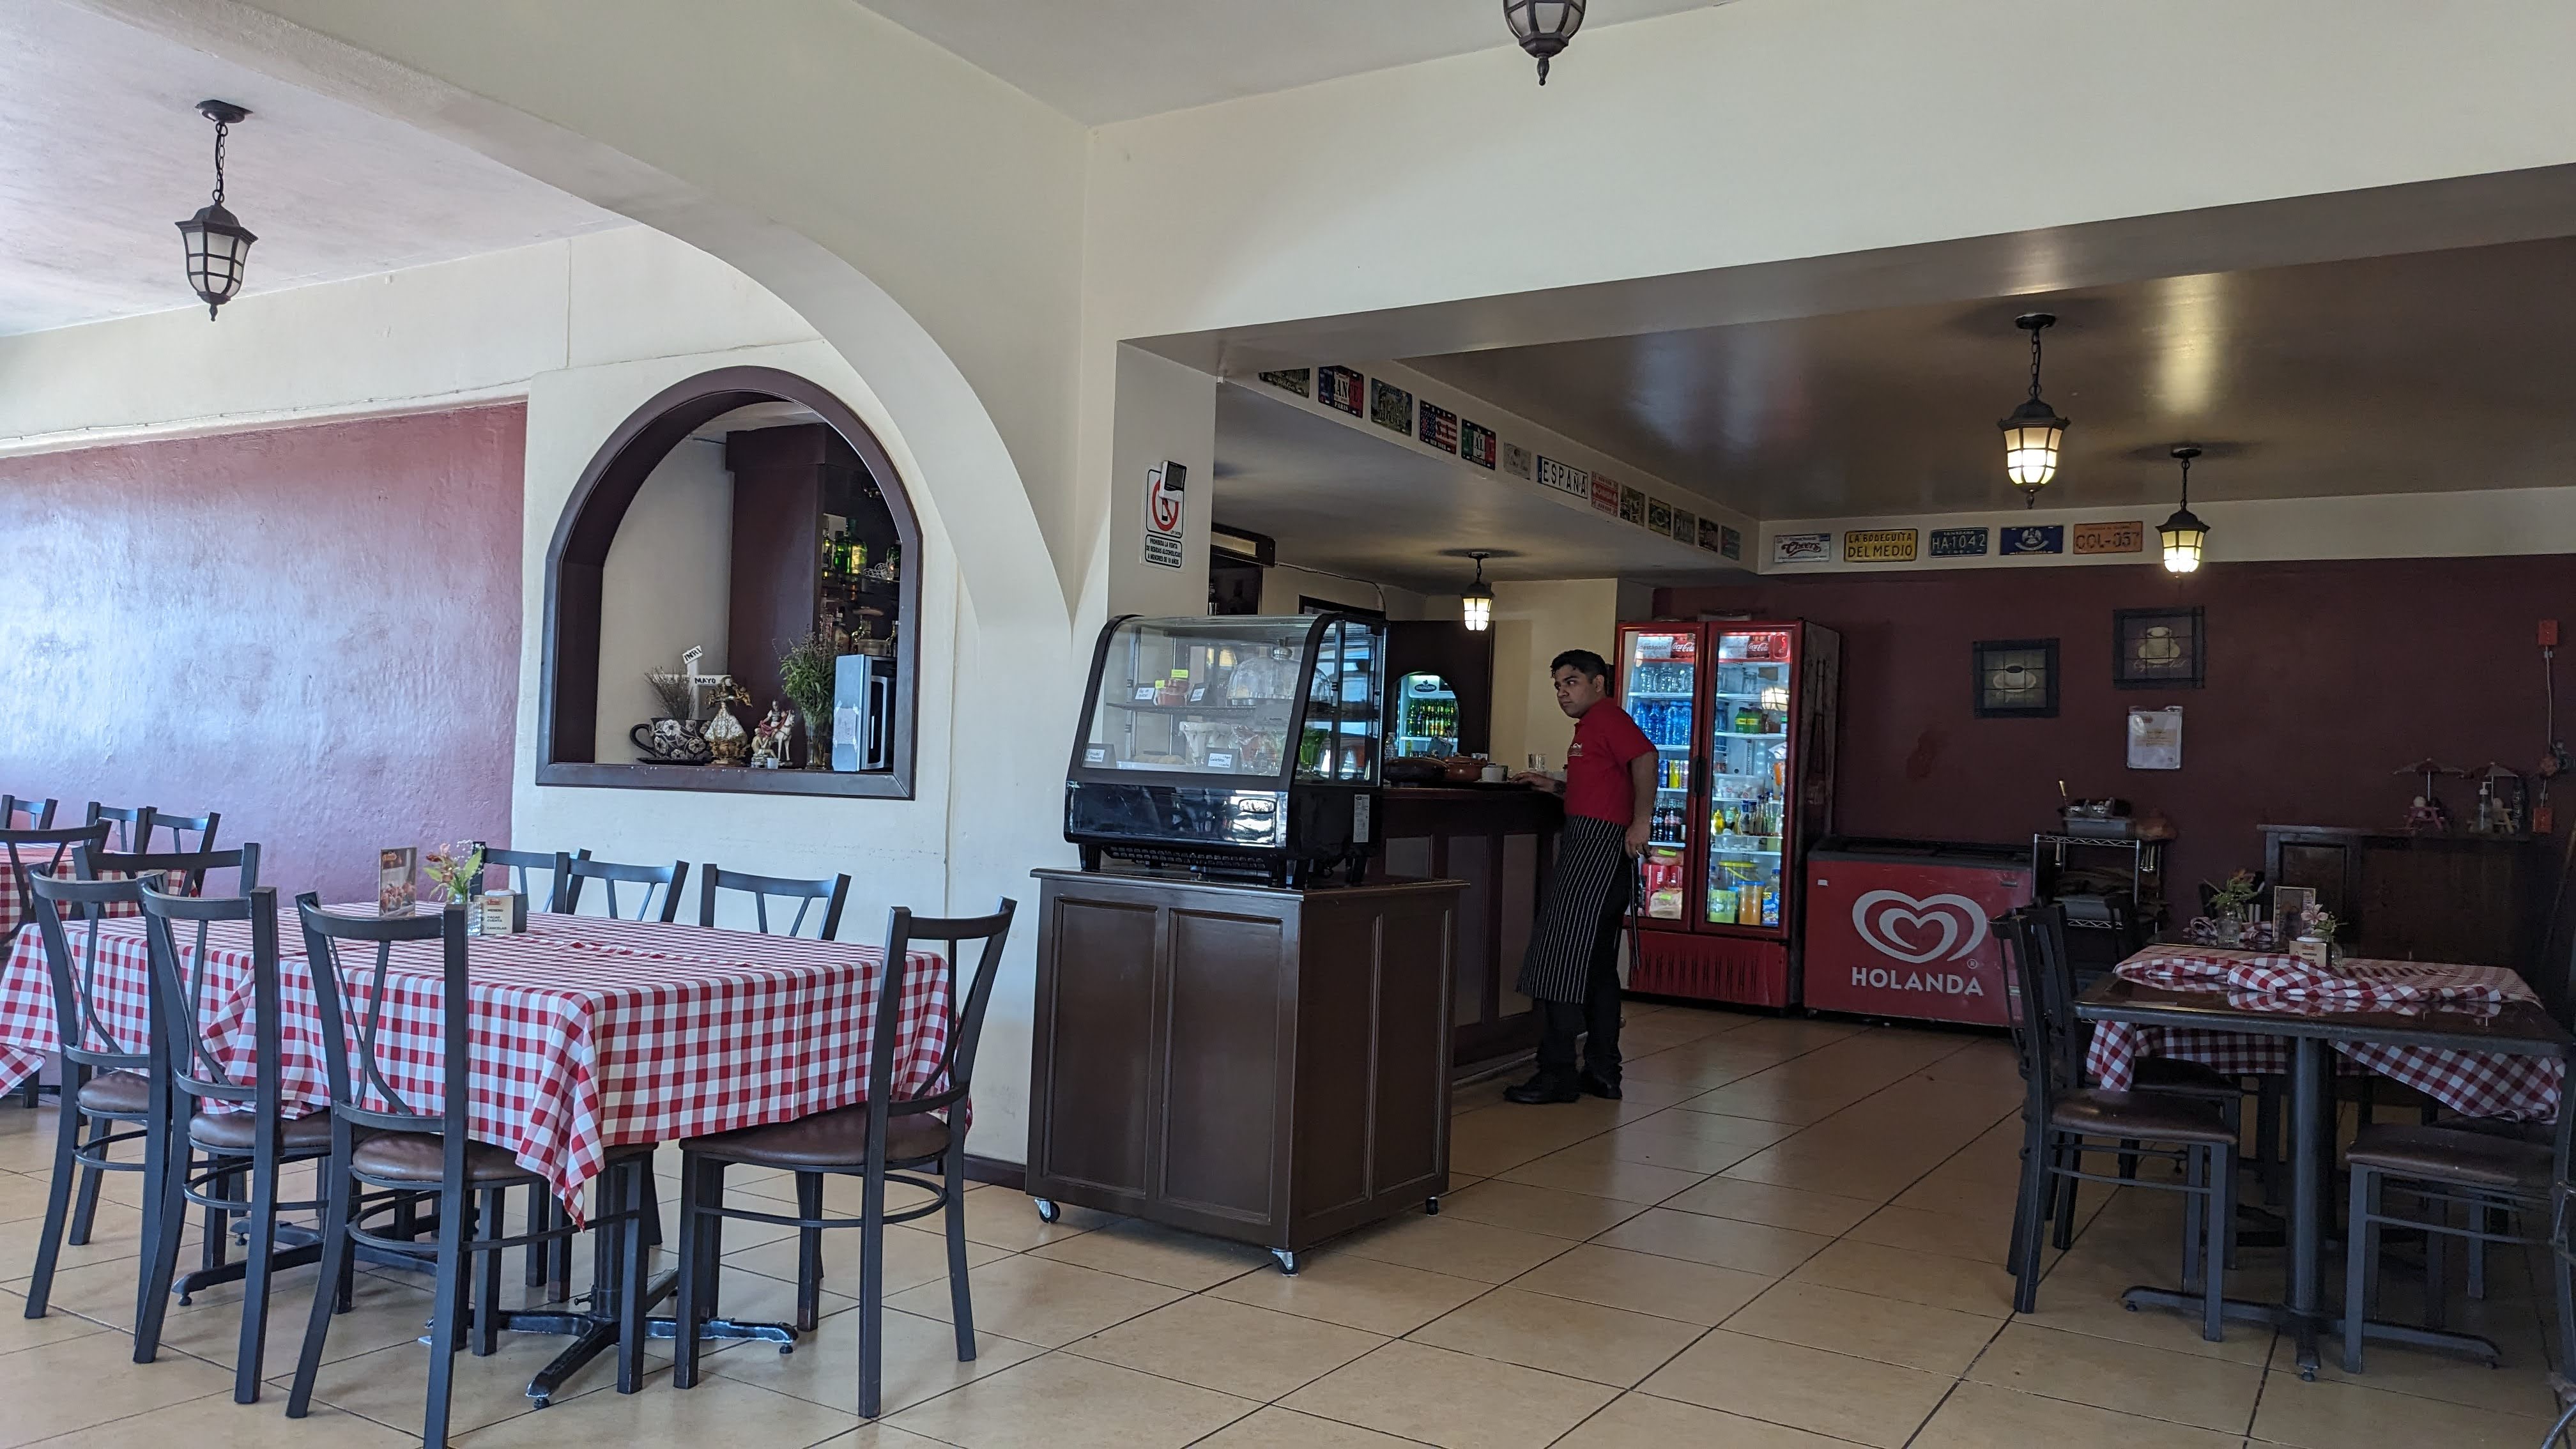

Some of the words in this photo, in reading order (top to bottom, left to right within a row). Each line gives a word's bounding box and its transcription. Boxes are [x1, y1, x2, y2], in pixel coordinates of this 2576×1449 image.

[1334, 401, 1349, 411] PARIS
[1543, 461, 1586, 495] ESPAÑA
[1849, 534, 1860, 543] LA
[1863, 532, 1912, 542] BODEGUITA
[1848, 546, 1869, 557] DEL
[1873, 545, 1913, 556] MEDIO
[684, 647, 702, 662] INRI
[1851, 965, 1984, 997] HOLANDA
